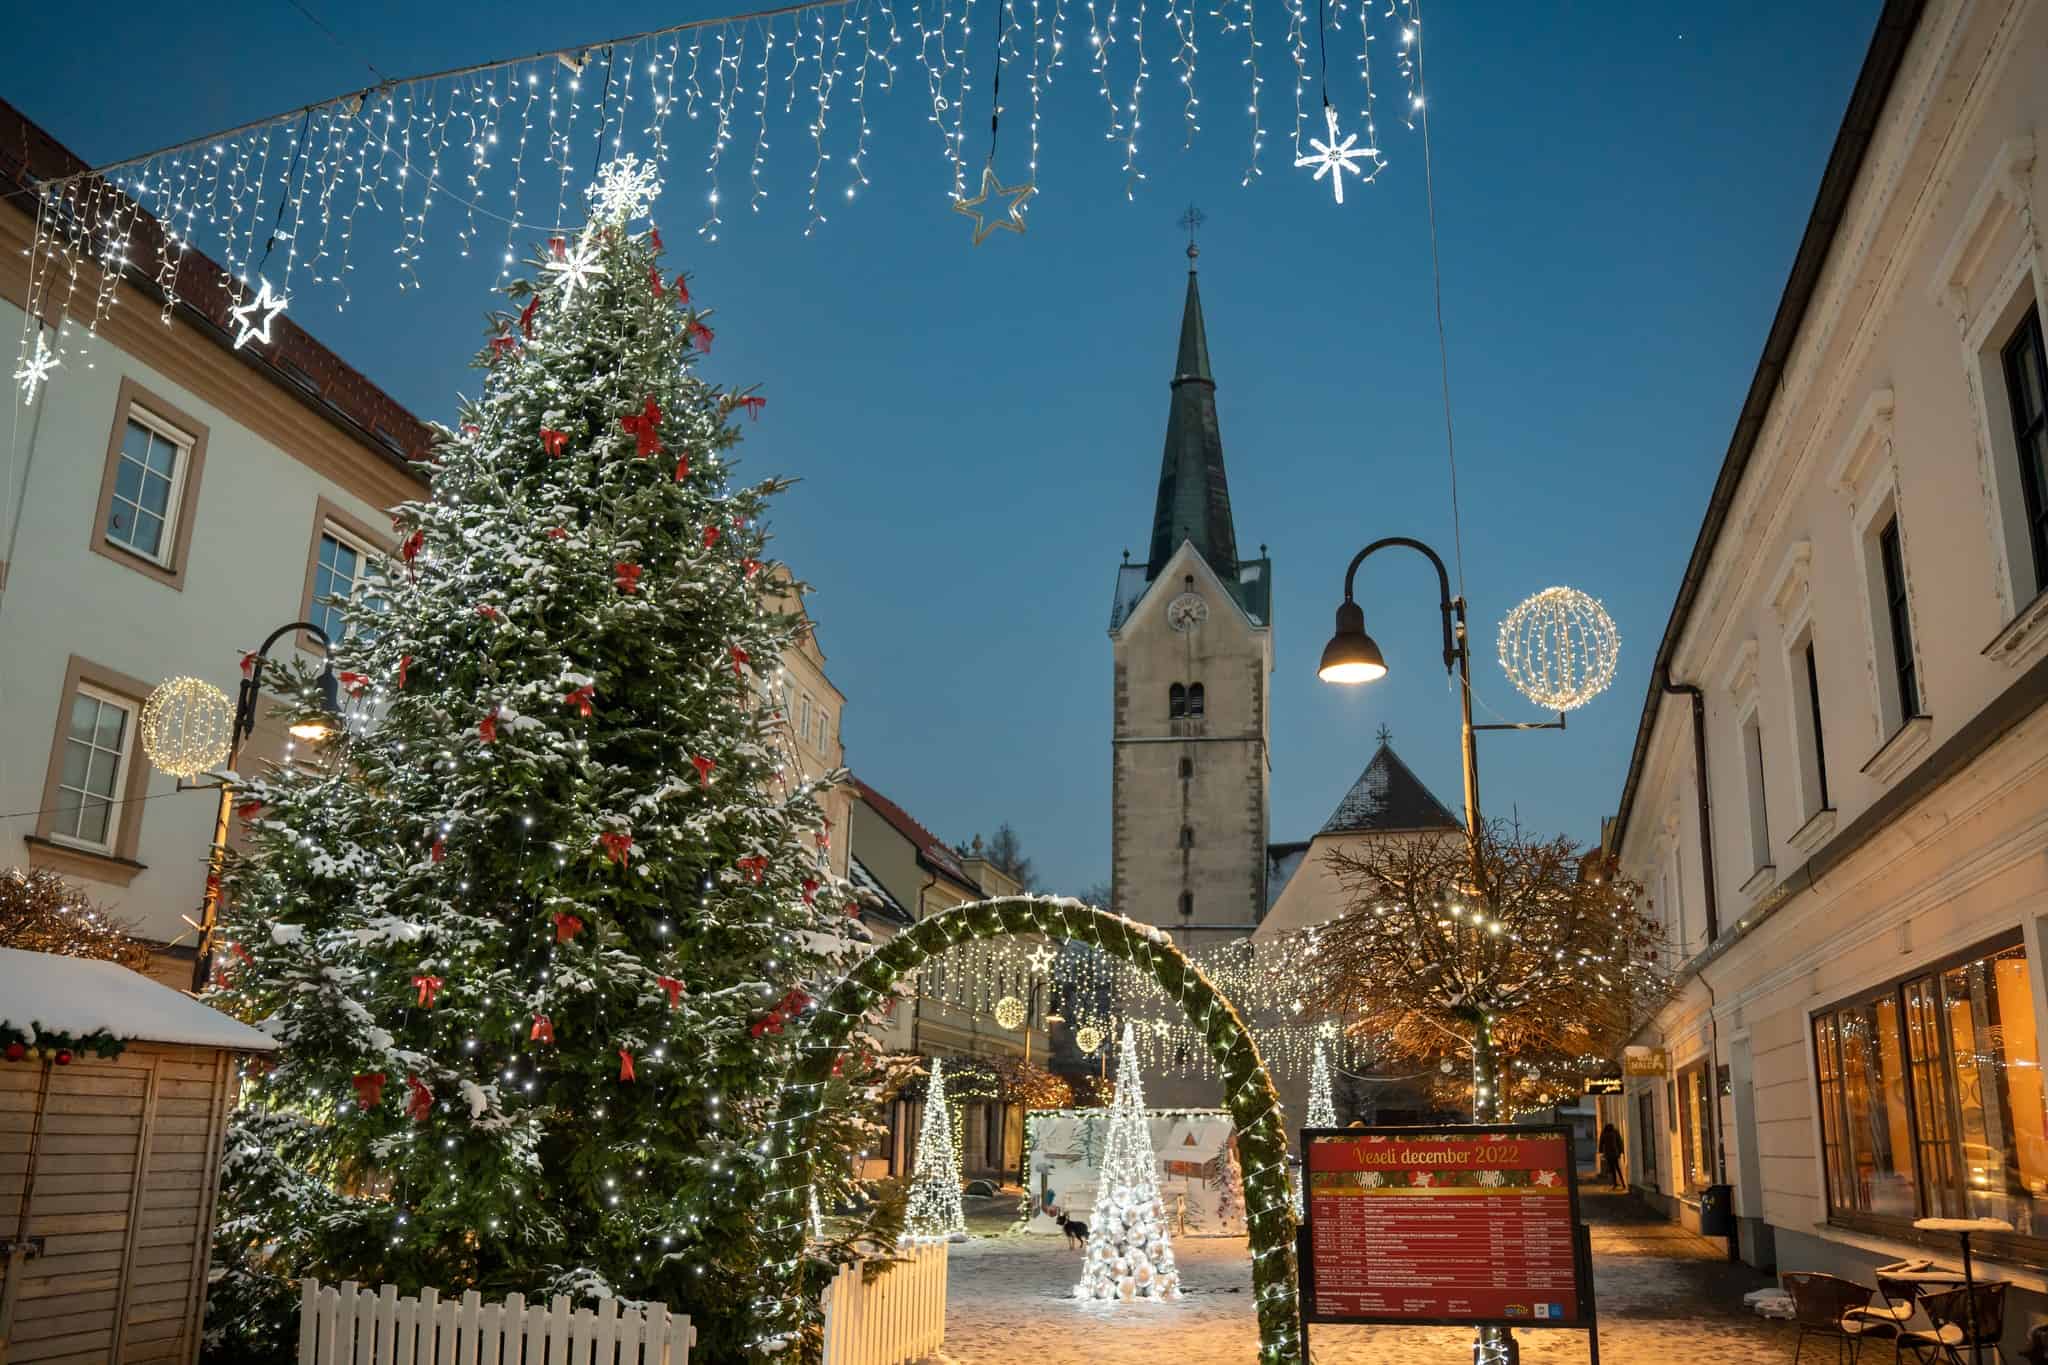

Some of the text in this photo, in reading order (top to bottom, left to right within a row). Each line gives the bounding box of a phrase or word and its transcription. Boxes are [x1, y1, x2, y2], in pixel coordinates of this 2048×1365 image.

[1353, 1145, 1520, 1165] Veseli december 2022
